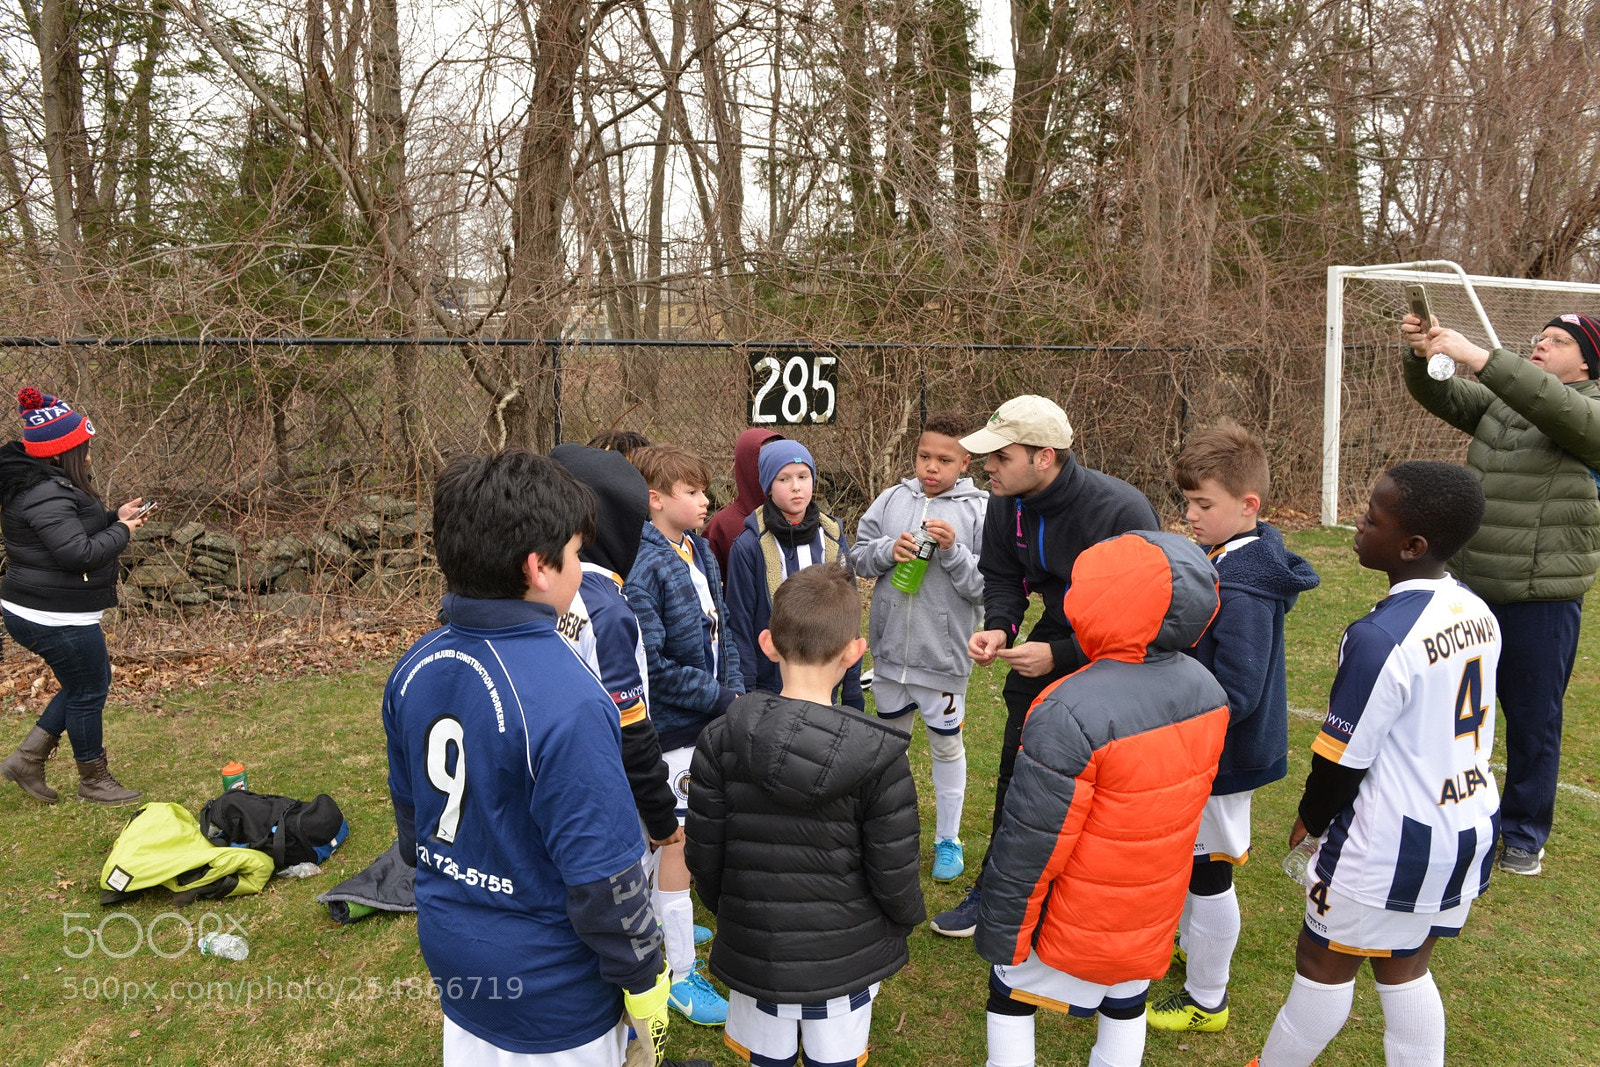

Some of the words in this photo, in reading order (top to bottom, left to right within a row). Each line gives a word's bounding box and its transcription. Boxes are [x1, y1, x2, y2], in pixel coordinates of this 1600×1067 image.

[752, 356, 836, 423] 285
[456, 651, 495, 690] CONSTRUCTION
[489, 688, 506, 734] WORKERS
[942, 691, 957, 716] 2
[1454, 655, 1490, 755] 4
[1328, 712, 1354, 736] WYSL
[424, 712, 466, 846] 9
[433, 853, 514, 895] 725-5755
[1309, 880, 1332, 917] 4
